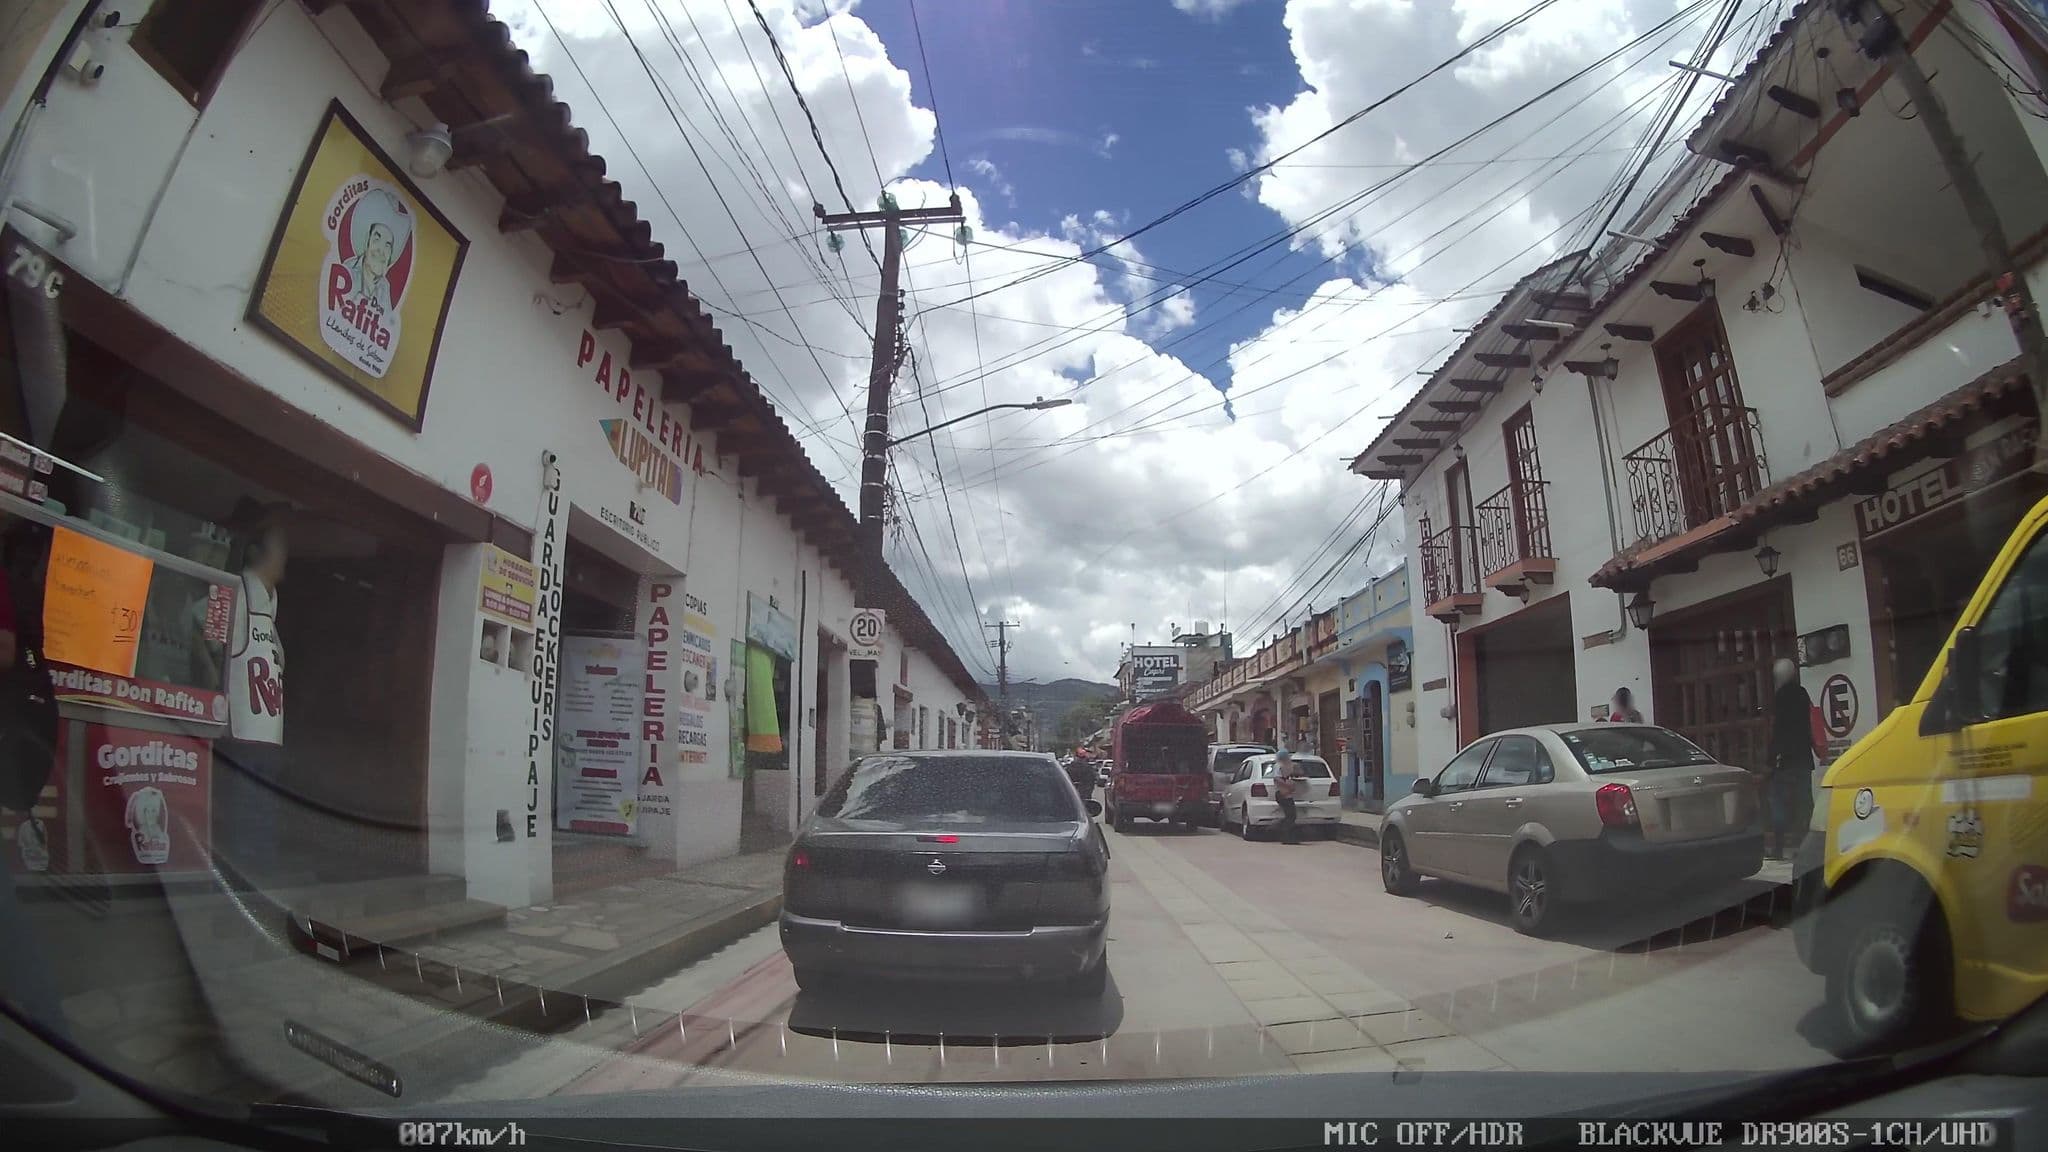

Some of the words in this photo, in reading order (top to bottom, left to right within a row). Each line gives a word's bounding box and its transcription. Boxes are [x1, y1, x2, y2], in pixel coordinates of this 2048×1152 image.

[327, 179, 369, 231] Gorditas
[328, 263, 391, 350] Rafita
[370, 296, 384, 316] Don
[577, 328, 703, 478] PAPELERIA
[1862, 468, 1961, 532] HOTEL
[685, 593, 707, 616] COPIAS
[857, 618, 876, 637] 20
[541, 563, 561, 741] LOCKERS
[1134, 656, 1177, 668] HOTEL
[49, 669, 112, 695] orditas
[116, 679, 150, 703] Don
[155, 687, 205, 715] Rafita
[641, 583, 672, 787] PAPELERIA
[1829, 684, 1850, 728] E
[98, 741, 198, 770] Gorditas
[527, 628, 546, 838] EQUIPAJE
